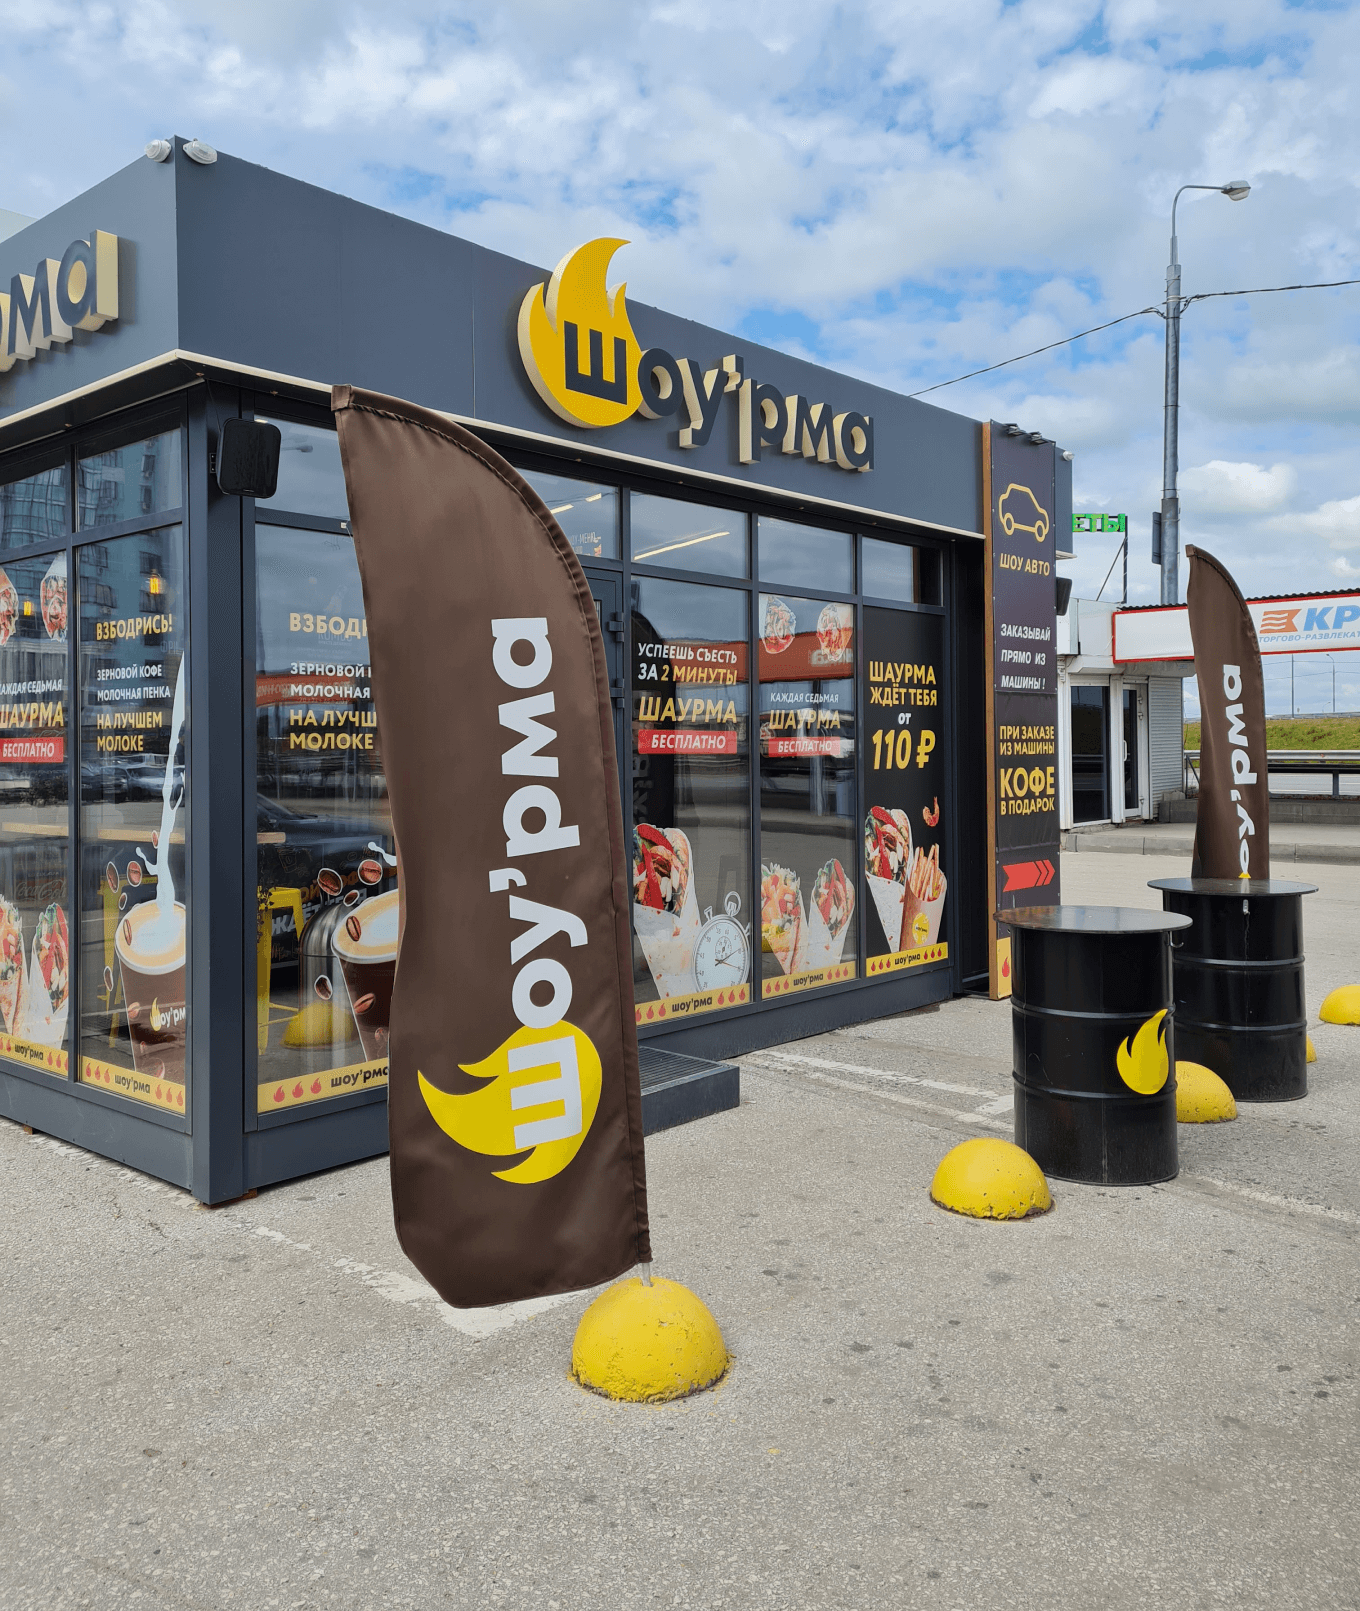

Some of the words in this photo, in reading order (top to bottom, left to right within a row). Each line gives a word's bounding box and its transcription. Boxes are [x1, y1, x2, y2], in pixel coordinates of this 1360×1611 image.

[0, 229, 118, 372] ма
[999, 552, 1024, 571] ШОУ
[1024, 558, 1050, 576] АВТО
[96, 613, 173, 640] ВЗБОДРИСЬ!
[1000, 623, 1051, 642] ЗАКАЗЫВАЙ
[637, 642, 694, 660] УСПЕЕШЬ
[696, 647, 738, 664] СЪЕСТЬ
[1000, 649, 1032, 665] ПРЯМО
[1034, 652, 1046, 666] ИЗ
[97, 663, 138, 681] ЗЕРНОВОЙ
[139, 664, 163, 678] КОФЕ
[290, 662, 365, 678] ЗЕРНОВОЙ
[638, 662, 659, 680] ЗА
[661, 664, 670, 681] 2
[672, 665, 738, 685] МИНУТЫ
[869, 660, 937, 685] ШАУРМА
[27, 679, 63, 695] СЕДЬМАЯ
[97, 686, 141, 701] МОЛОЧНАЯ
[142, 686, 171, 699] ПЕНКА
[290, 684, 371, 699] МОЛОЧНАЯ
[870, 683, 908, 707] ЖДЁТ
[909, 688, 938, 707] ТЕБЯ
[770, 692, 804, 704] КАЖДАЯ
[804, 693, 839, 704] СЕДЬМАЯ
[289, 709, 317, 727] НА
[638, 695, 738, 723] ШАУРМА
[97, 714, 113, 730] НА
[113, 711, 163, 729] ЛУЧШЕМ
[769, 709, 841, 730] ШАУРМА
[289, 733, 374, 750] МОЛОКЕ
[999, 725, 1020, 740] ПРИ
[1021, 725, 1055, 740] ЗАКАЗЕ
[2, 742, 55, 758] БЕСПЛАТНО
[97, 735, 144, 752] МОЛОКЕ
[651, 734, 726, 750] БЕСПЛАТНО
[778, 739, 832, 753] БЕСПЛАТНО
[872, 729, 912, 770] 110
[999, 741, 1013, 756] ИЗ
[1013, 741, 1055, 755] МАШИНЫ
[1000, 766, 1055, 798] КОФЕ
[1000, 800, 1007, 815] В
[1008, 797, 1055, 816] ПОДАРОК
